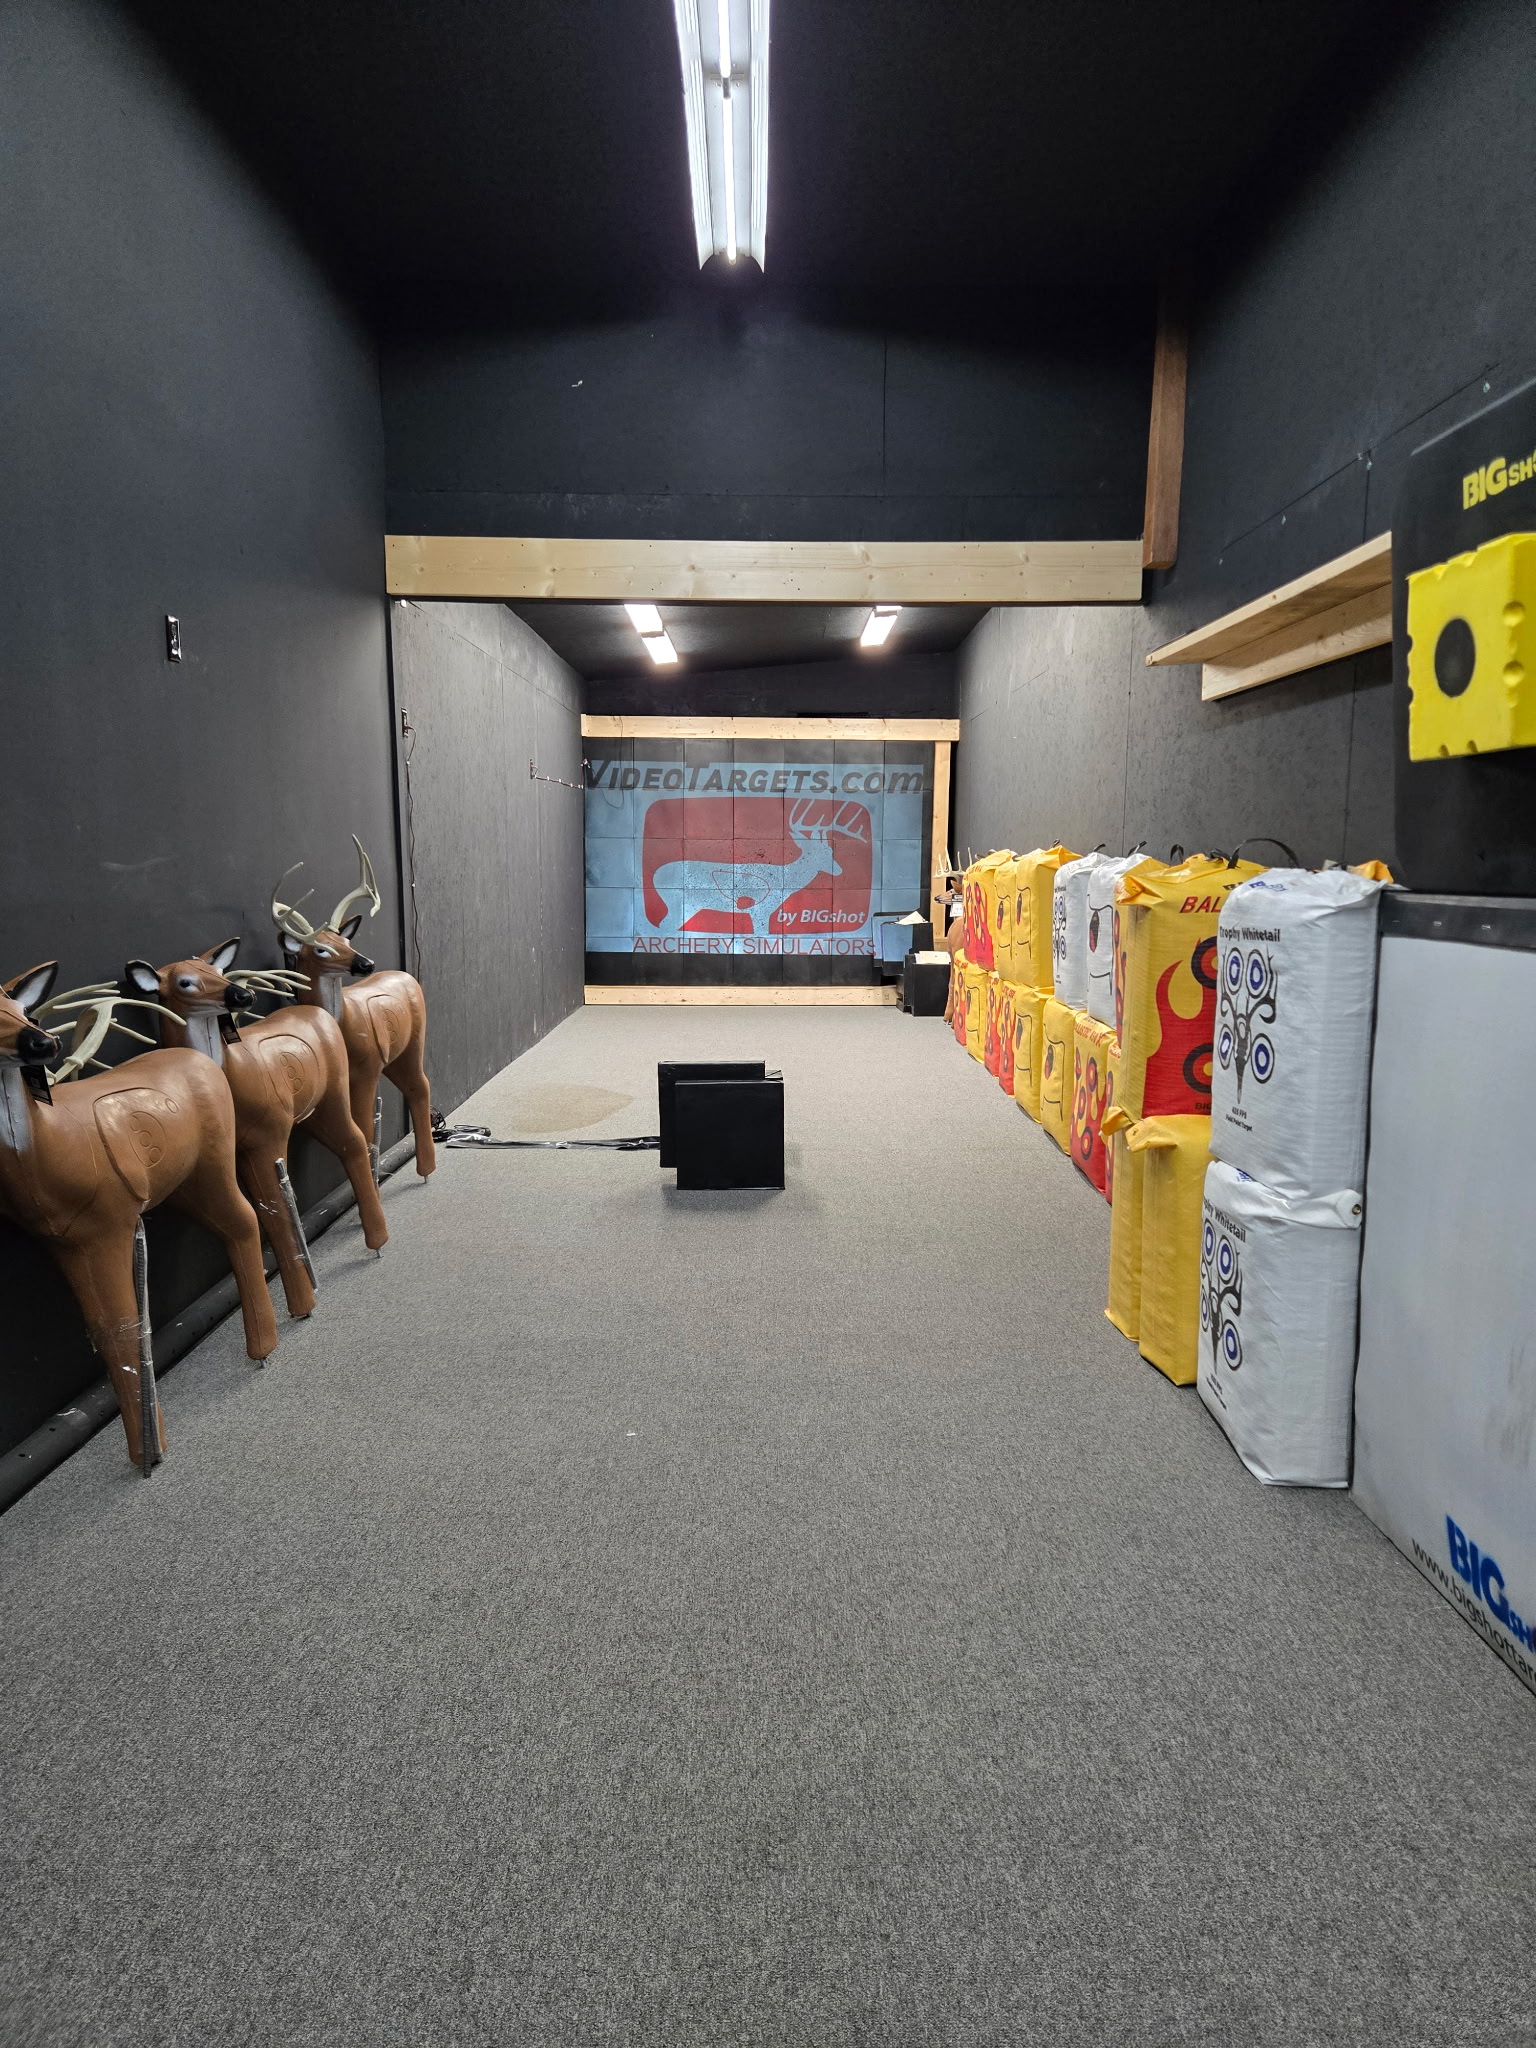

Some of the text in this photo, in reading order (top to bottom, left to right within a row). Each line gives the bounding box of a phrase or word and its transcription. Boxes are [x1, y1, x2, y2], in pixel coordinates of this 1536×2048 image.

[1463, 448, 1536, 510] BIGSH
[777, 909, 865, 926] by BIGshot
[1219, 926, 1280, 942] Trophy Whitetail
[633, 937, 876, 956] ARCHERY SIMULATORS
[1215, 1207, 1246, 1242] Whitetail
